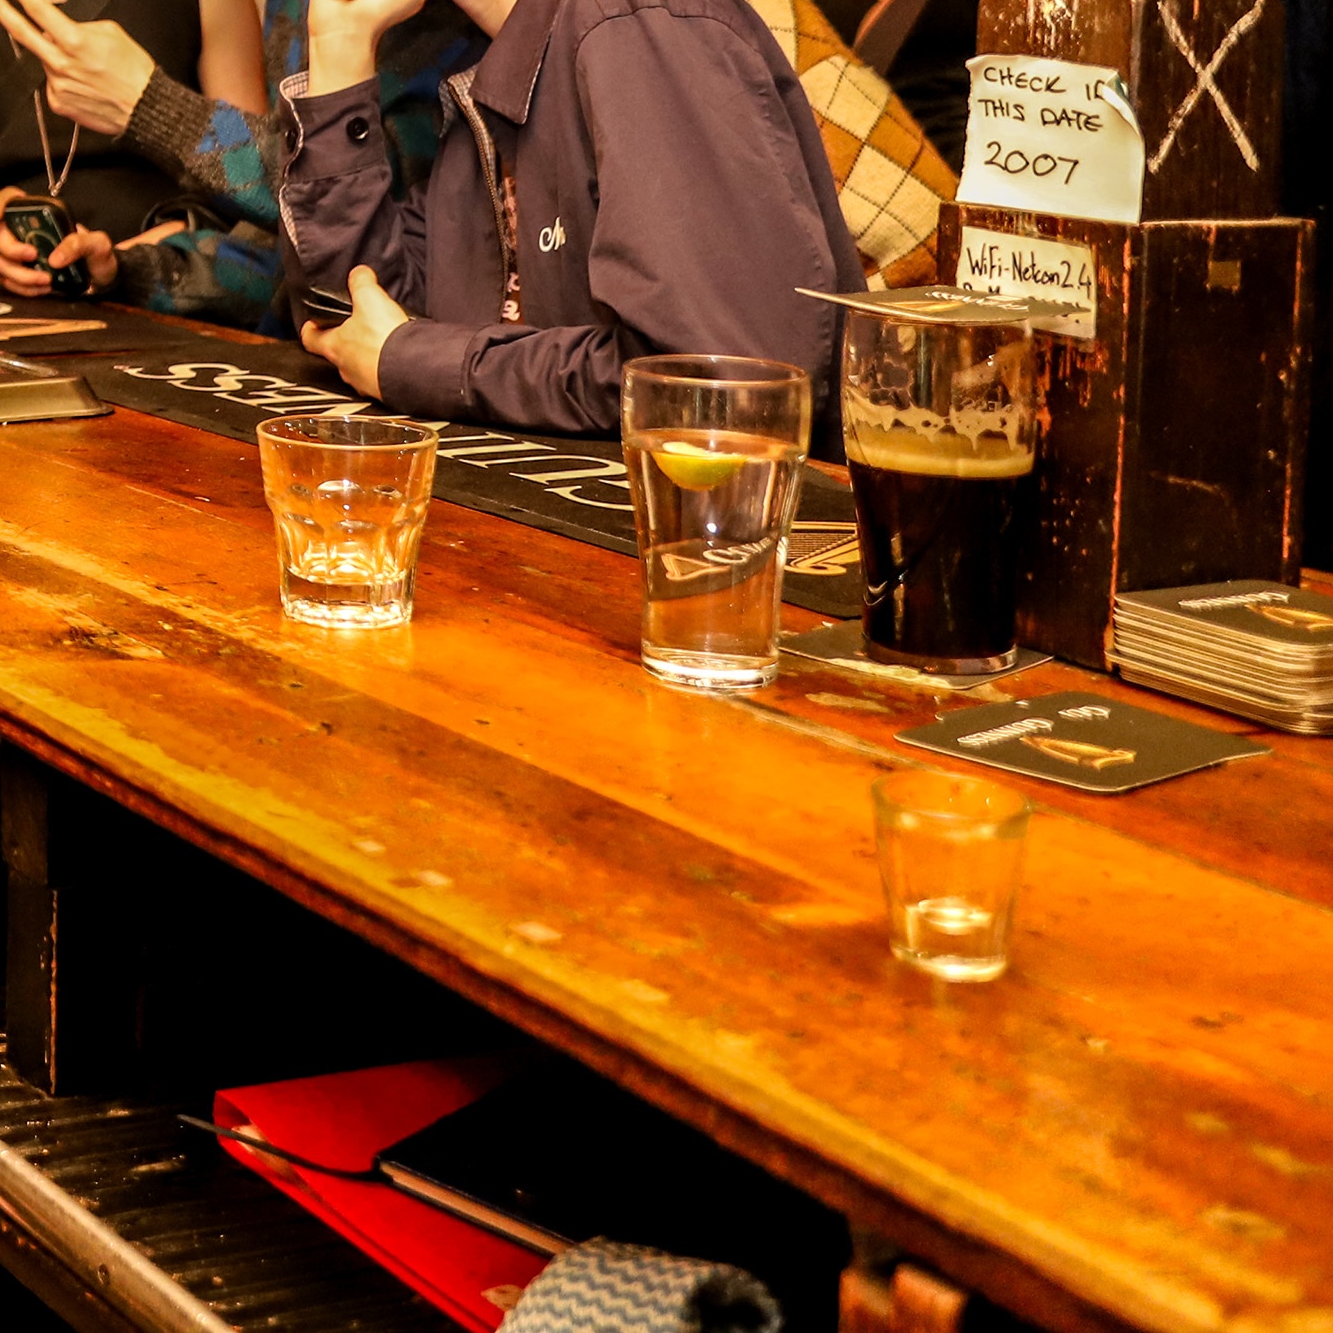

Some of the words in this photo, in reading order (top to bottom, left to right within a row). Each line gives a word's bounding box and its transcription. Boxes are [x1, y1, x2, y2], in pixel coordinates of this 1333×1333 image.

[982, 66, 1067, 94] CHECK
[978, 98, 1026, 121] THIS
[1041, 107, 1104, 132] DATE
[984, 141, 1080, 185] 2007
